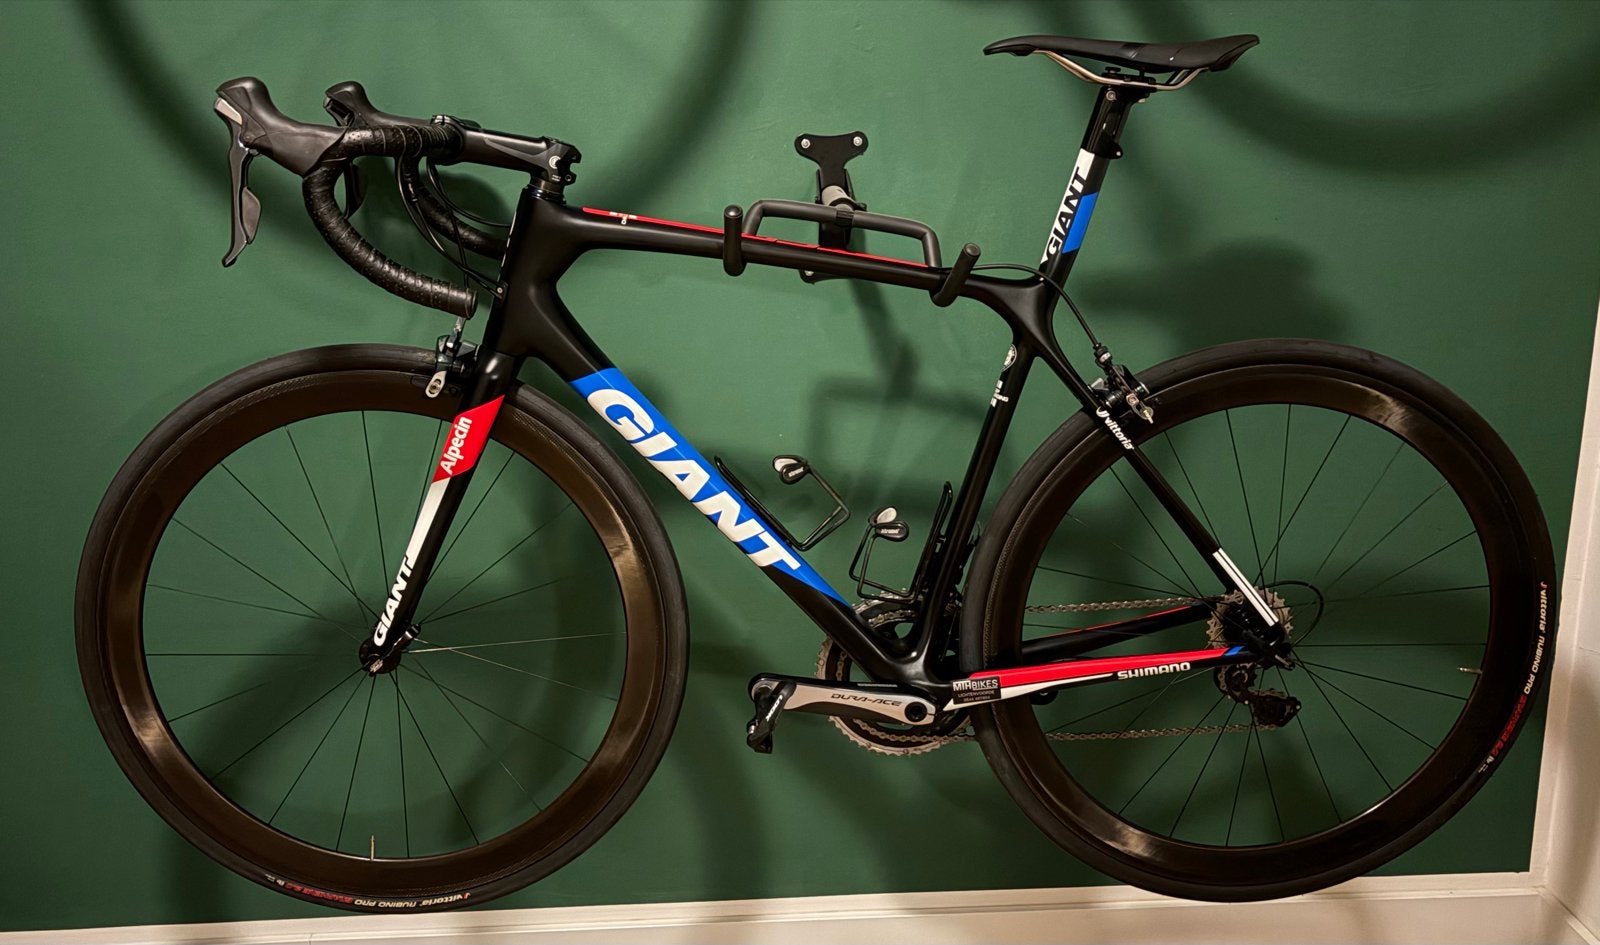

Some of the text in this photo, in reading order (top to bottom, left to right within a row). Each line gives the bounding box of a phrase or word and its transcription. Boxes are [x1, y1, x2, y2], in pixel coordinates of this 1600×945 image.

[1046, 166, 1087, 259] GIANT
[440, 416, 473, 475] Alpecin
[1104, 416, 1135, 450] vittoria
[587, 388, 801, 570] GIANT
[373, 556, 413, 647] GIANT
[830, 693, 903, 707] DURA-ACE
[1117, 661, 1191, 680] SHIMANO
